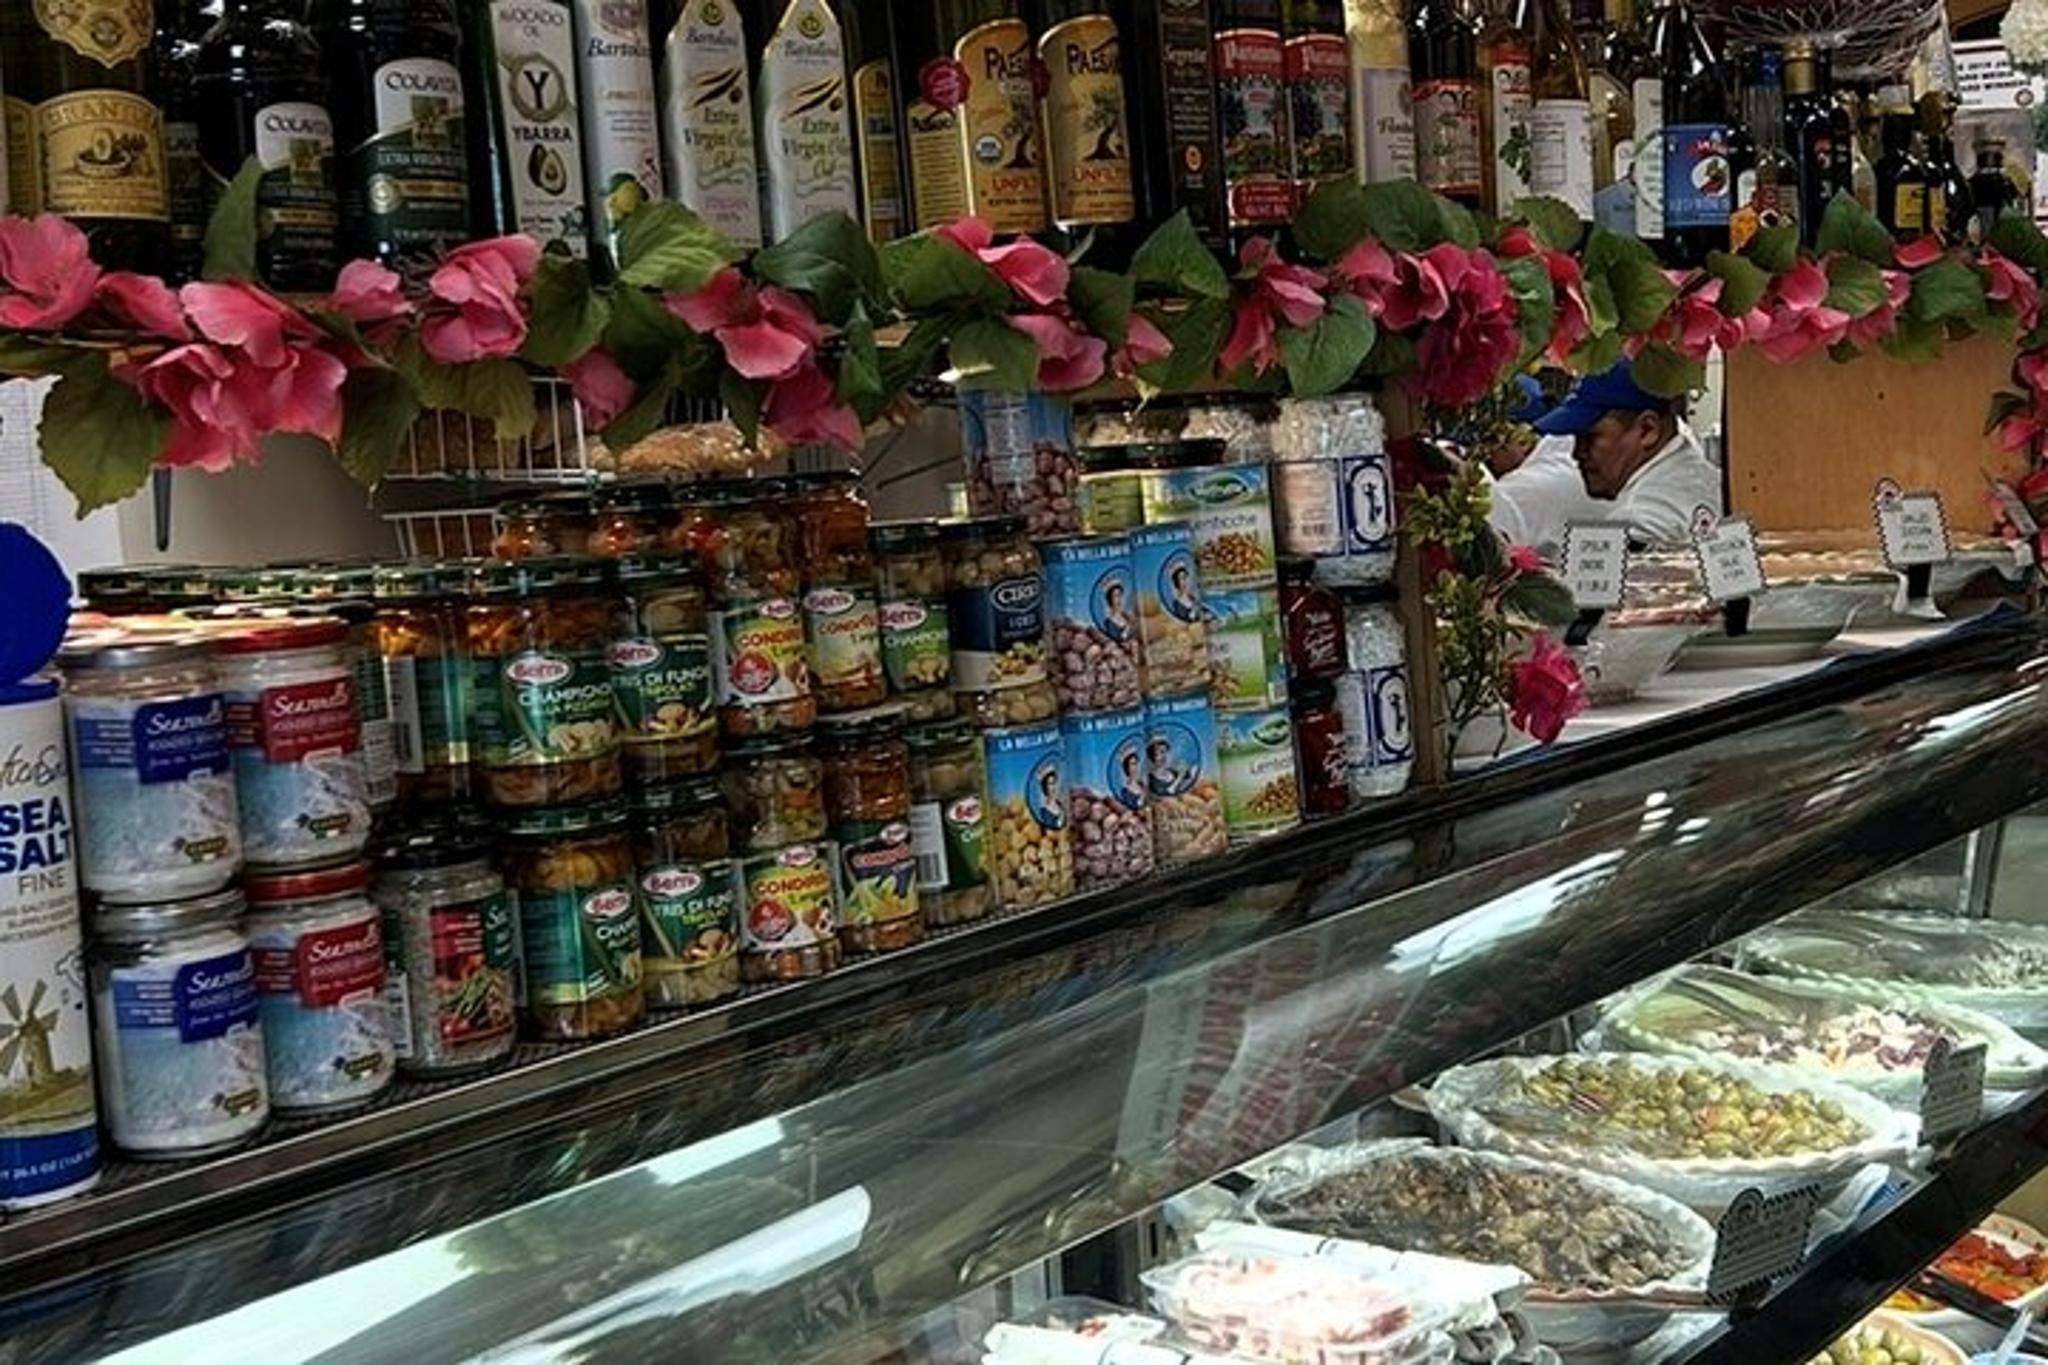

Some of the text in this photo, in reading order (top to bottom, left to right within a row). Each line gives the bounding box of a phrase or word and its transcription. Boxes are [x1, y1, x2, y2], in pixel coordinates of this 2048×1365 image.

[983, 46, 1024, 79] PAES
[523, 70, 550, 110] Y
[704, 107, 739, 124] Extra
[802, 117, 840, 134] Extra
[511, 125, 573, 142] YBARRA
[0, 796, 67, 837] SEA
[0, 829, 73, 874] SALT
[18, 867, 67, 898] FINE
